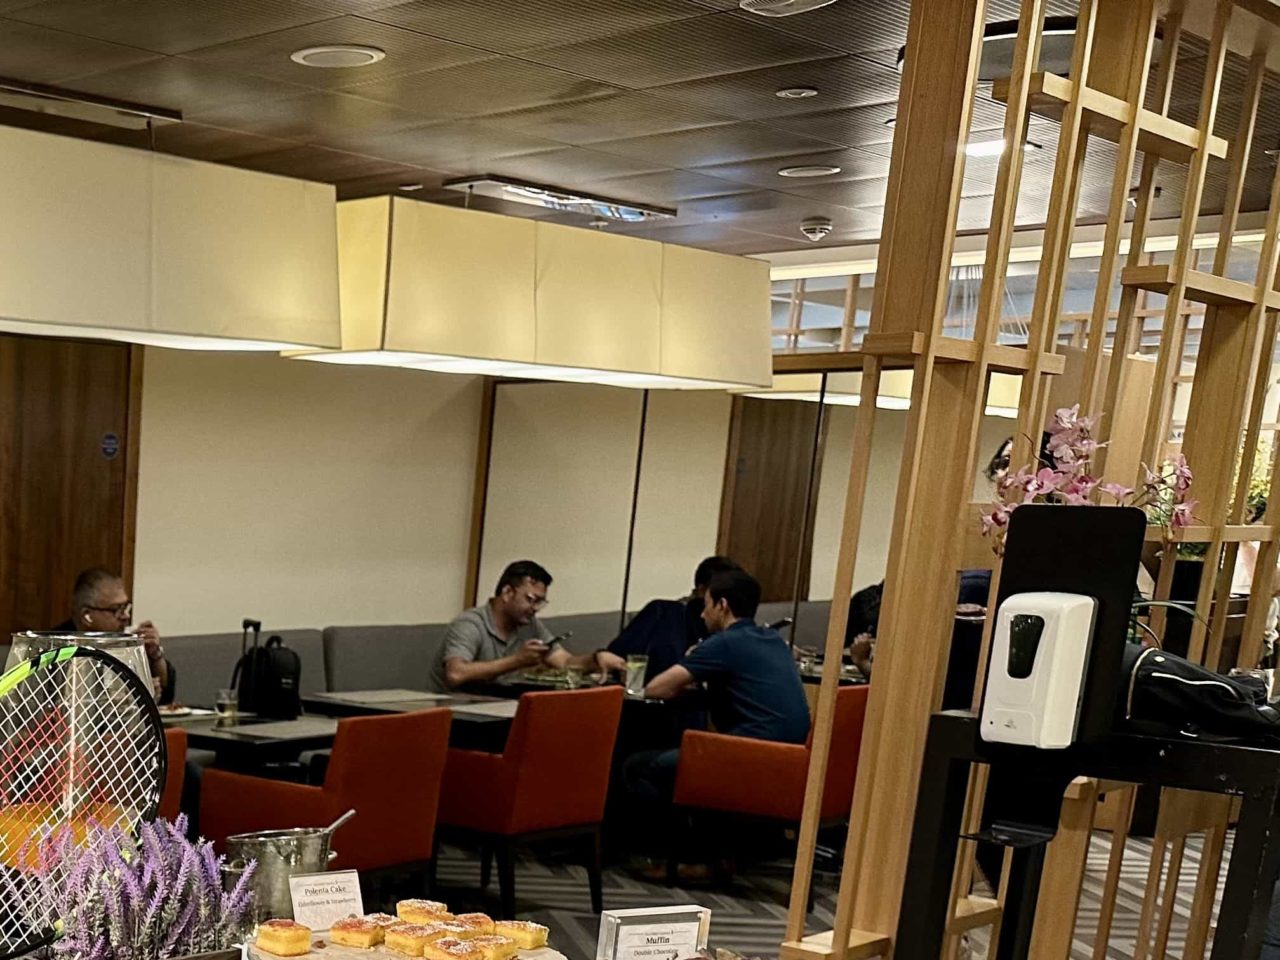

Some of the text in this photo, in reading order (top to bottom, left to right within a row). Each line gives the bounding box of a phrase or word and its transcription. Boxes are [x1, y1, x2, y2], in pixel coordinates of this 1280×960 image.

[304, 885, 346, 896] Polenta Cake
[646, 936, 670, 945] Muffin
[633, 949, 652, 957] Double
